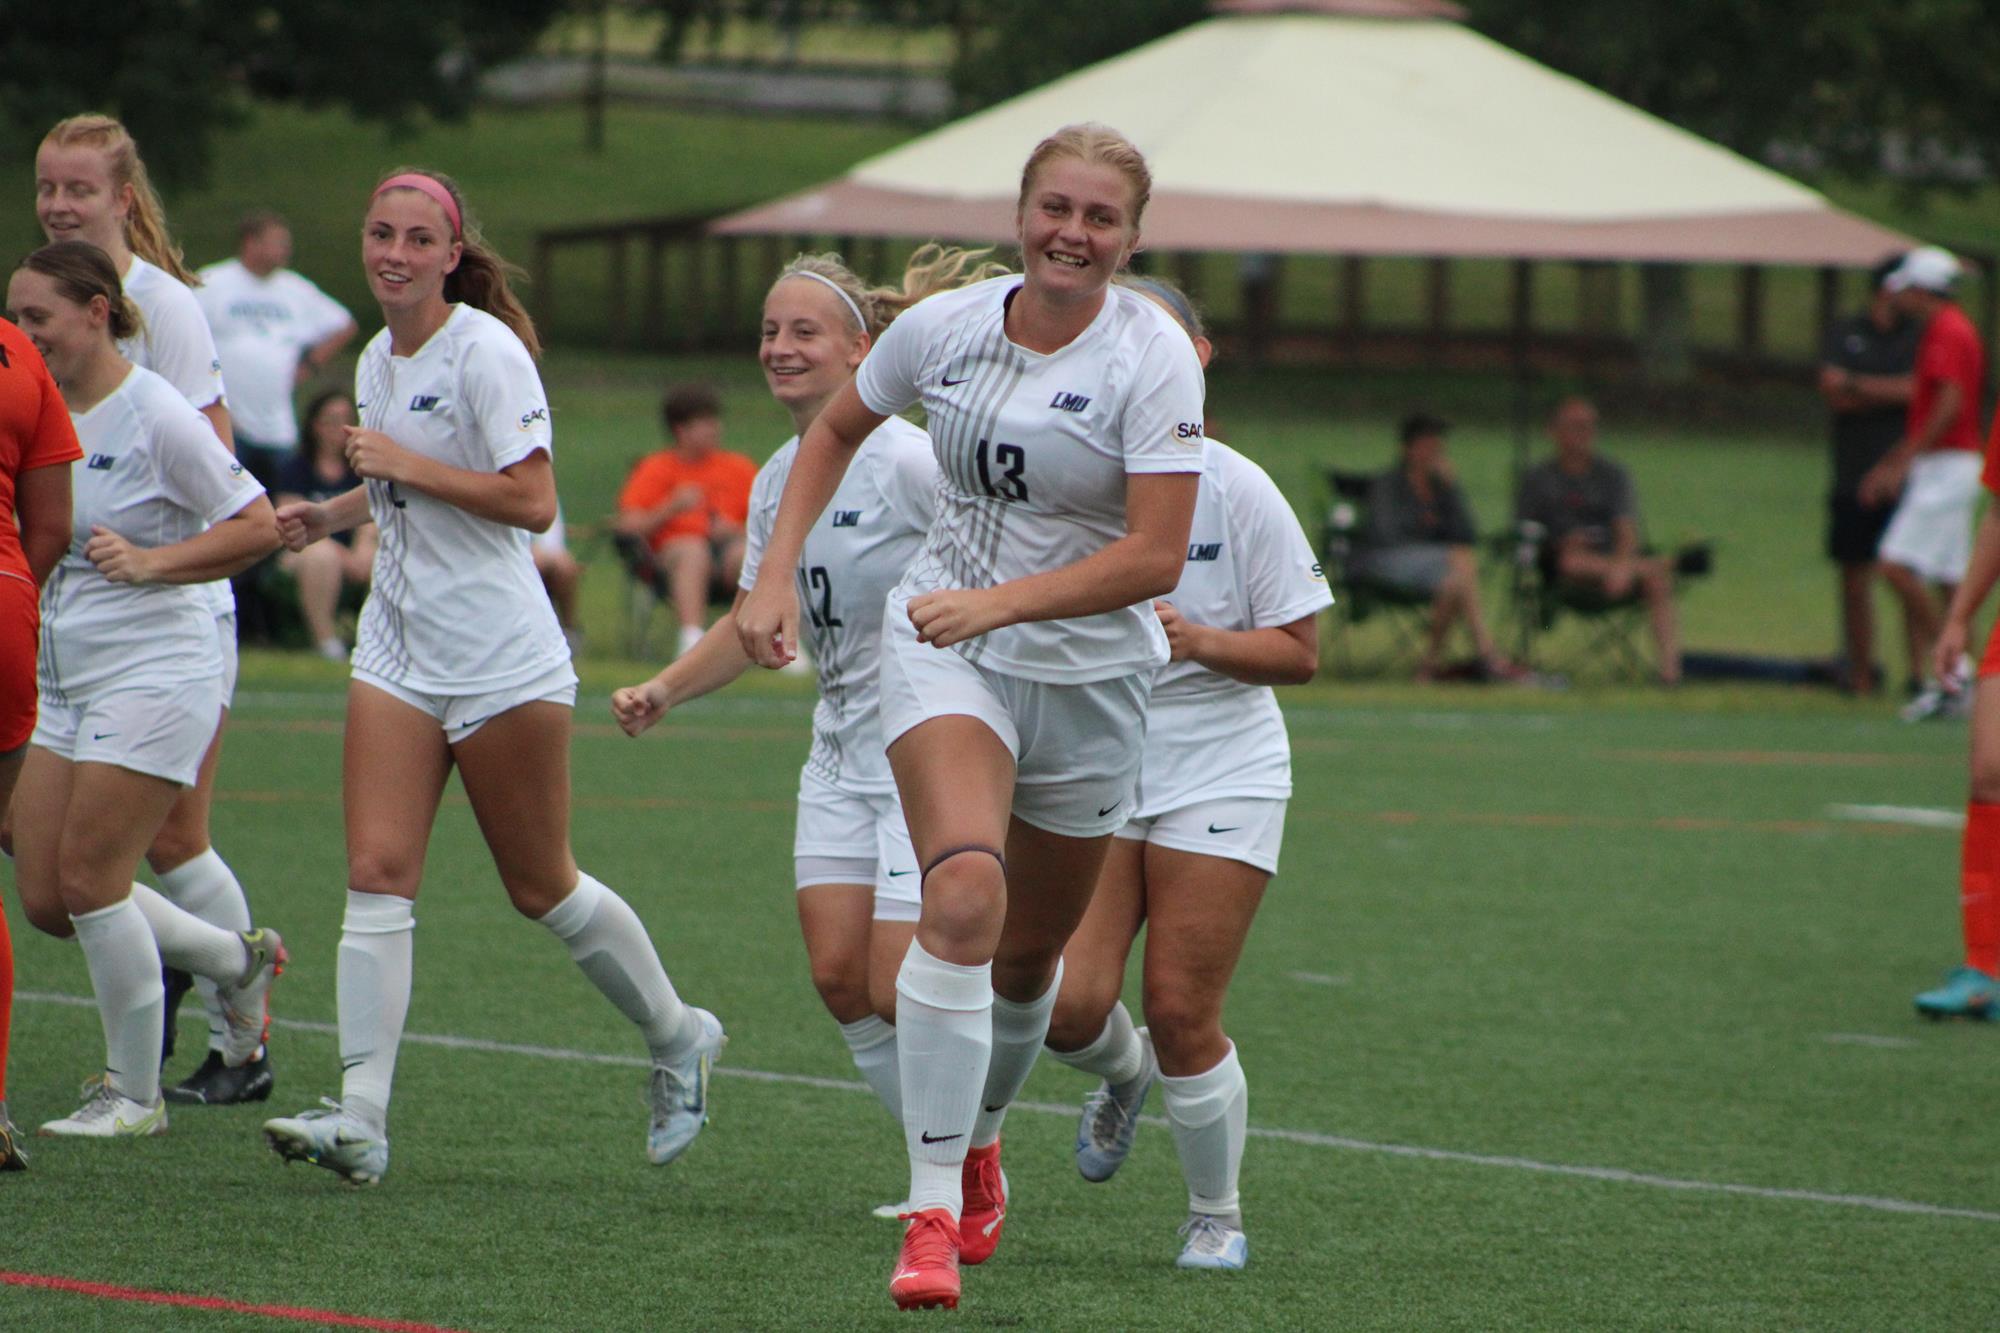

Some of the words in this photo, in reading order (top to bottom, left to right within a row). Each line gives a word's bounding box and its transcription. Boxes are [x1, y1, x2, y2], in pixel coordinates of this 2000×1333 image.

[1049, 391, 1091, 413] LMU
[521, 408, 546, 428] SAC
[976, 438, 1029, 503] 13
[832, 510, 863, 528] LMU
[1187, 543, 1224, 561] LMU
